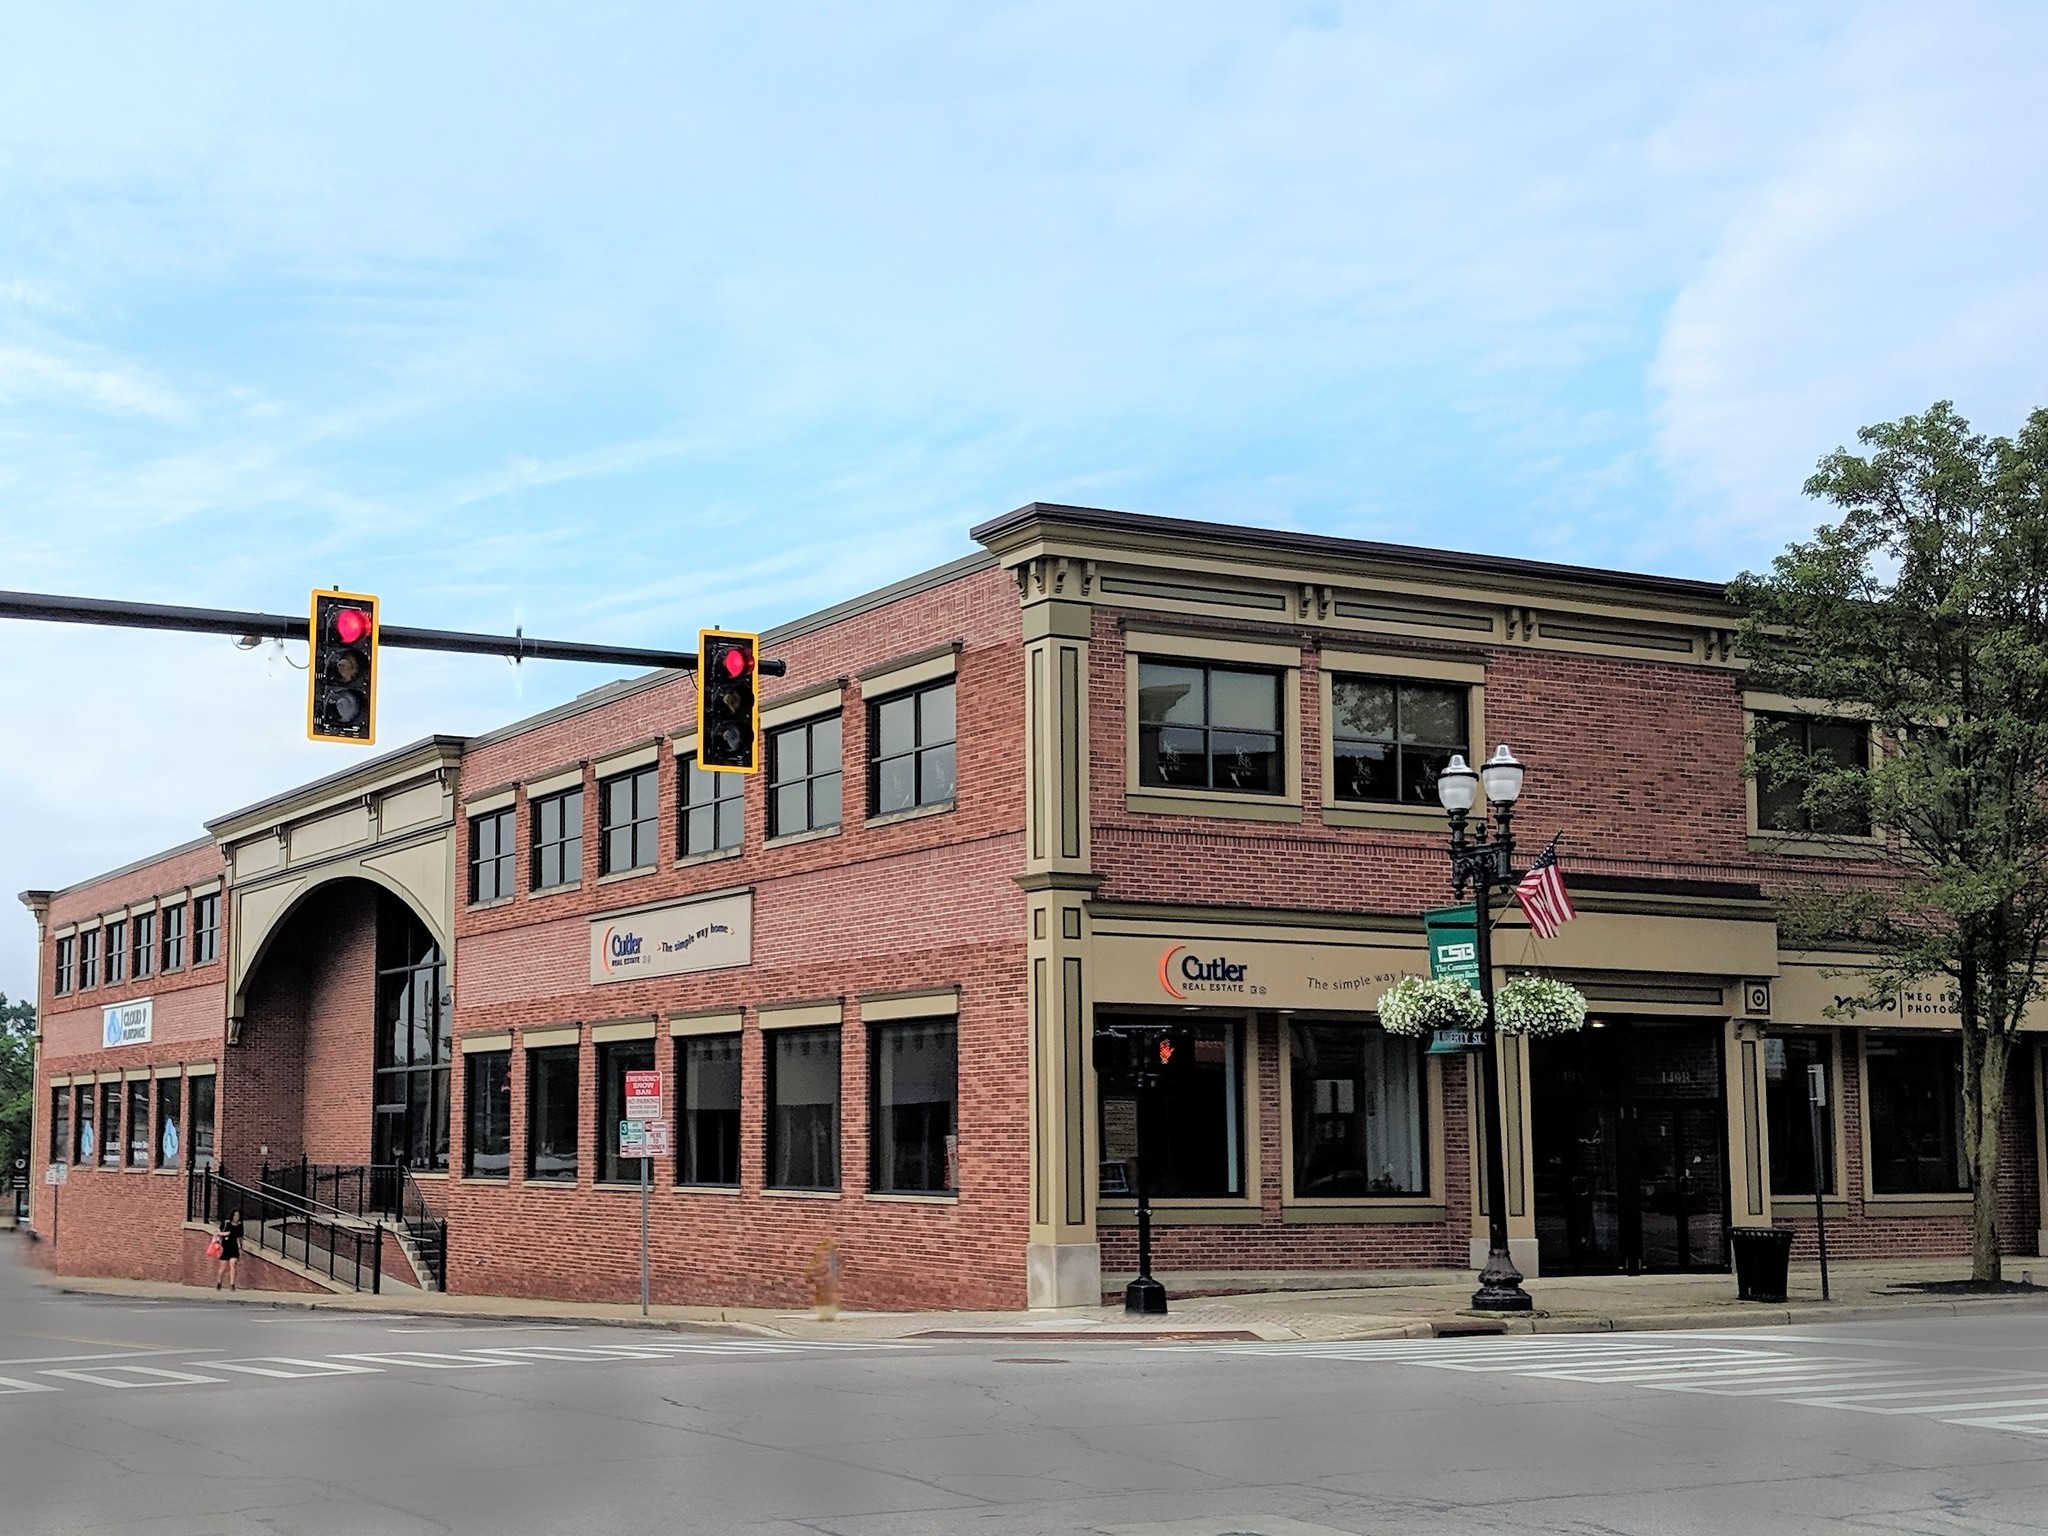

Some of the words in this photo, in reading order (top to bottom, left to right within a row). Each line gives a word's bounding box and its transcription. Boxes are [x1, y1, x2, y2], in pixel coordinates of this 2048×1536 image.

[612, 932, 643, 957] Cutler
[662, 941, 673, 953] The
[674, 934, 695, 951] simple
[696, 926, 709, 938] way
[710, 923, 728, 934] home
[1437, 943, 1475, 962] CSB
[1182, 955, 1247, 982] Cutler
[1182, 983, 1206, 991] REAL
[1210, 984, 1244, 993] ESTATE
[1307, 977, 1329, 990] The
[1332, 975, 1371, 992] simple
[1374, 972, 1396, 983] way
[1906, 992, 1932, 1002] MEG
